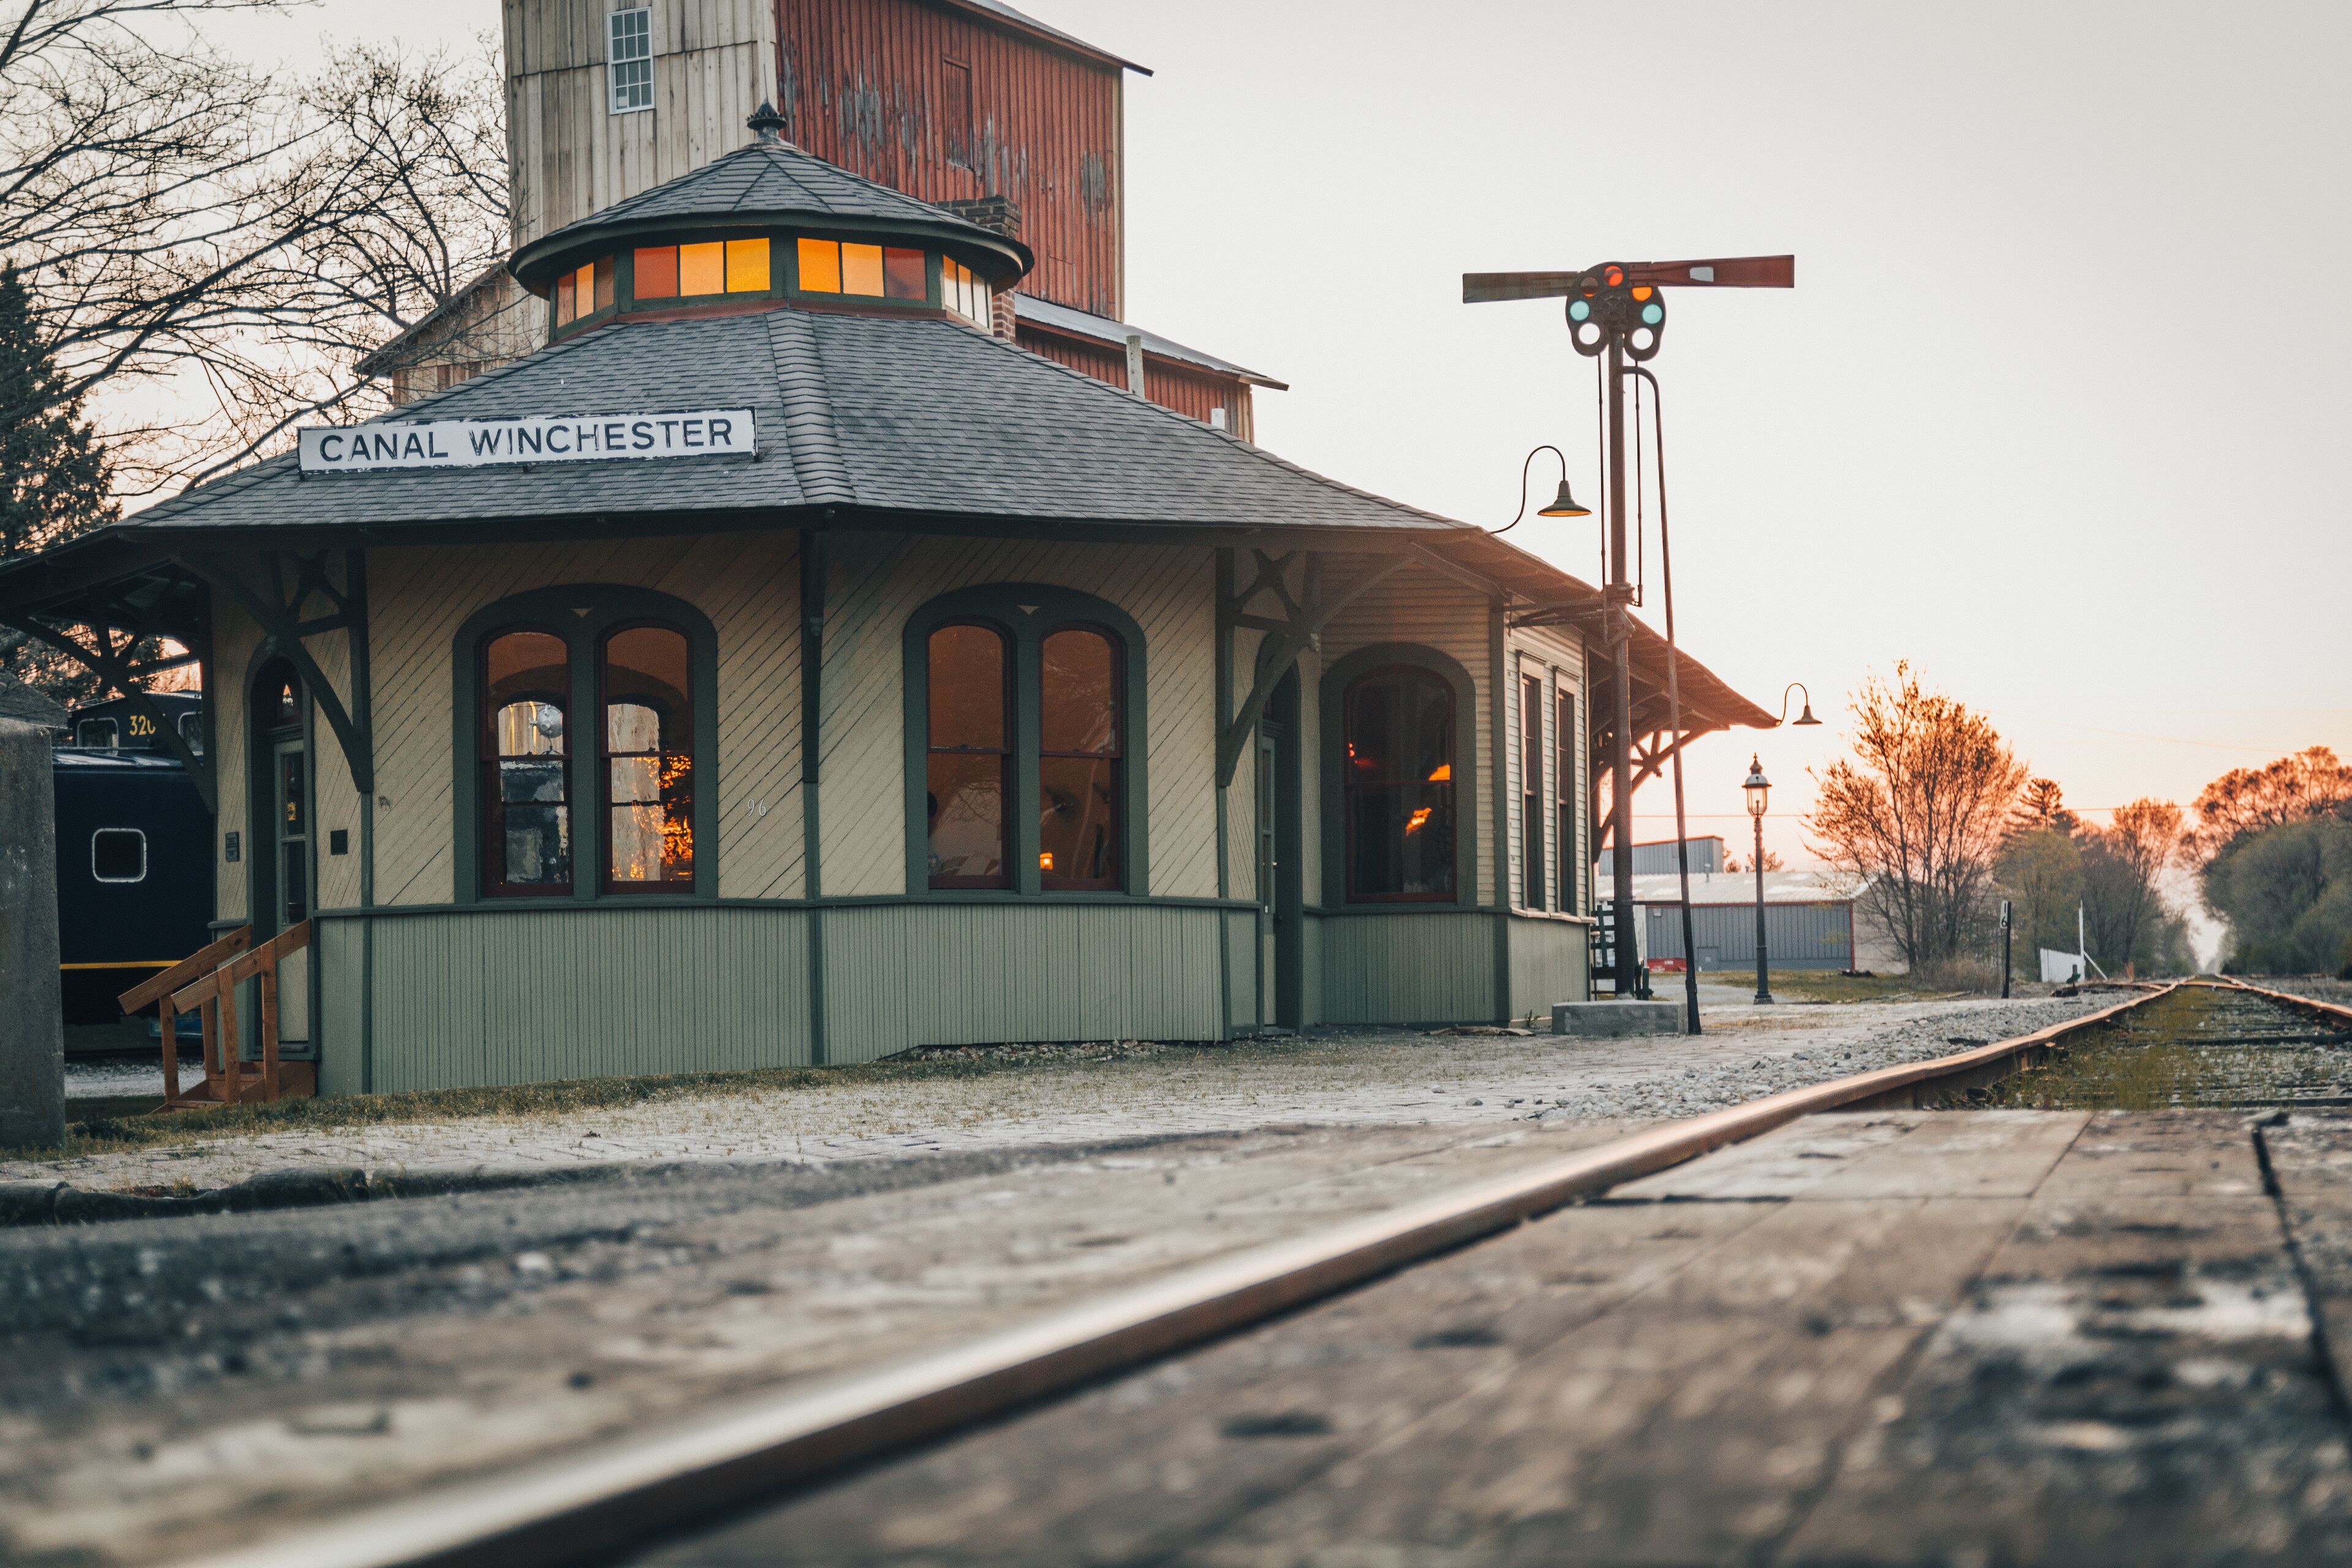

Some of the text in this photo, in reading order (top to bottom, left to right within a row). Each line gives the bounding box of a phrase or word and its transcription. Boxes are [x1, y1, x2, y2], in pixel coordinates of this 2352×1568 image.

[320, 418, 733, 462] CANAL WINCHESTER
[747, 798, 767, 817] 96
